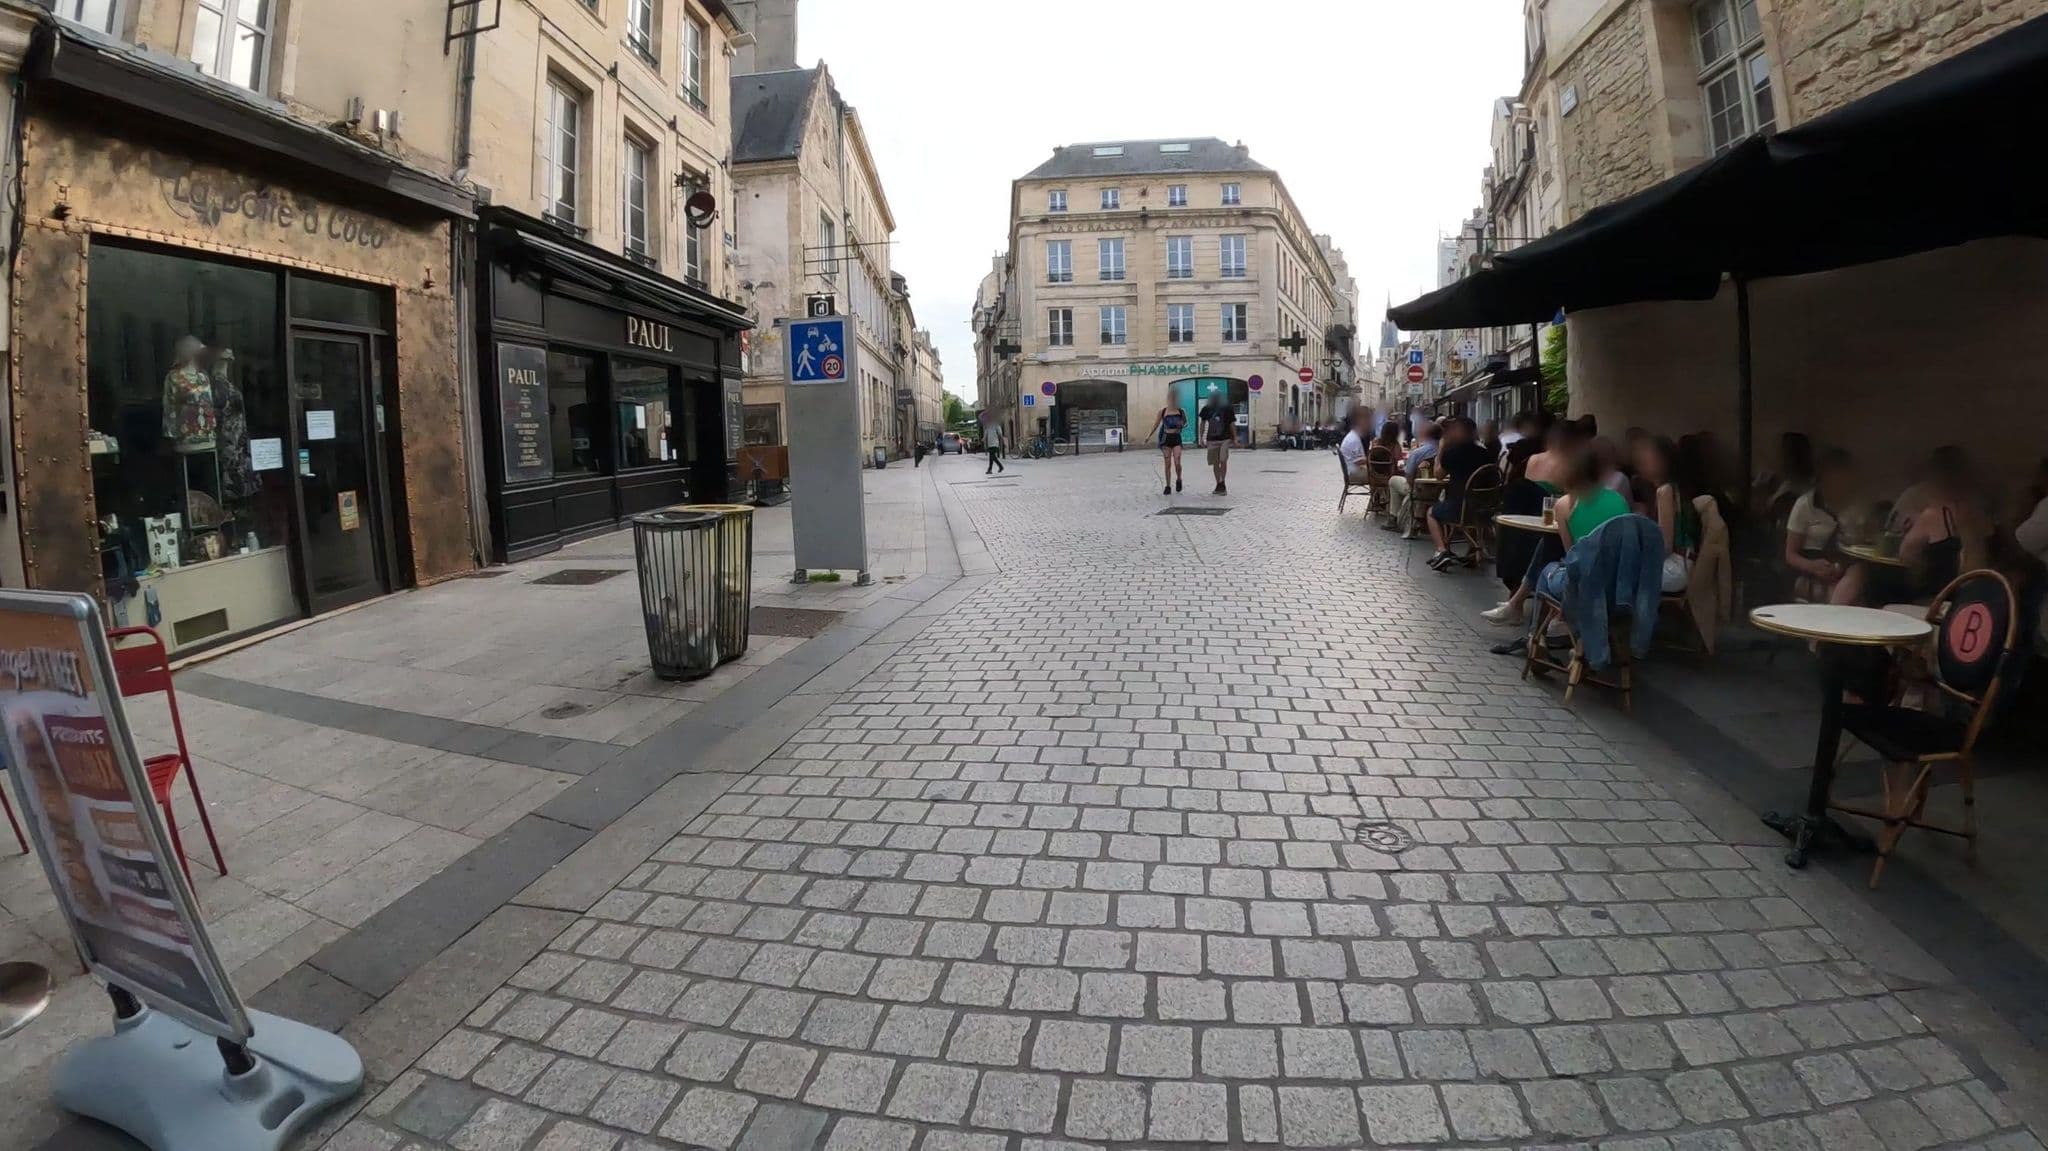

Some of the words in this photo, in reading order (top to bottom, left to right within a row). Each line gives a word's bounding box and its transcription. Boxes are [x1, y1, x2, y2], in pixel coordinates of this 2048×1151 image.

[327, 207, 384, 249] Coco
[627, 316, 673, 352] PAUL
[508, 367, 540, 386] PAUL
[826, 361, 840, 372] 20
[1129, 363, 1210, 376] PHARMACIE
[1959, 610, 1984, 653] B
